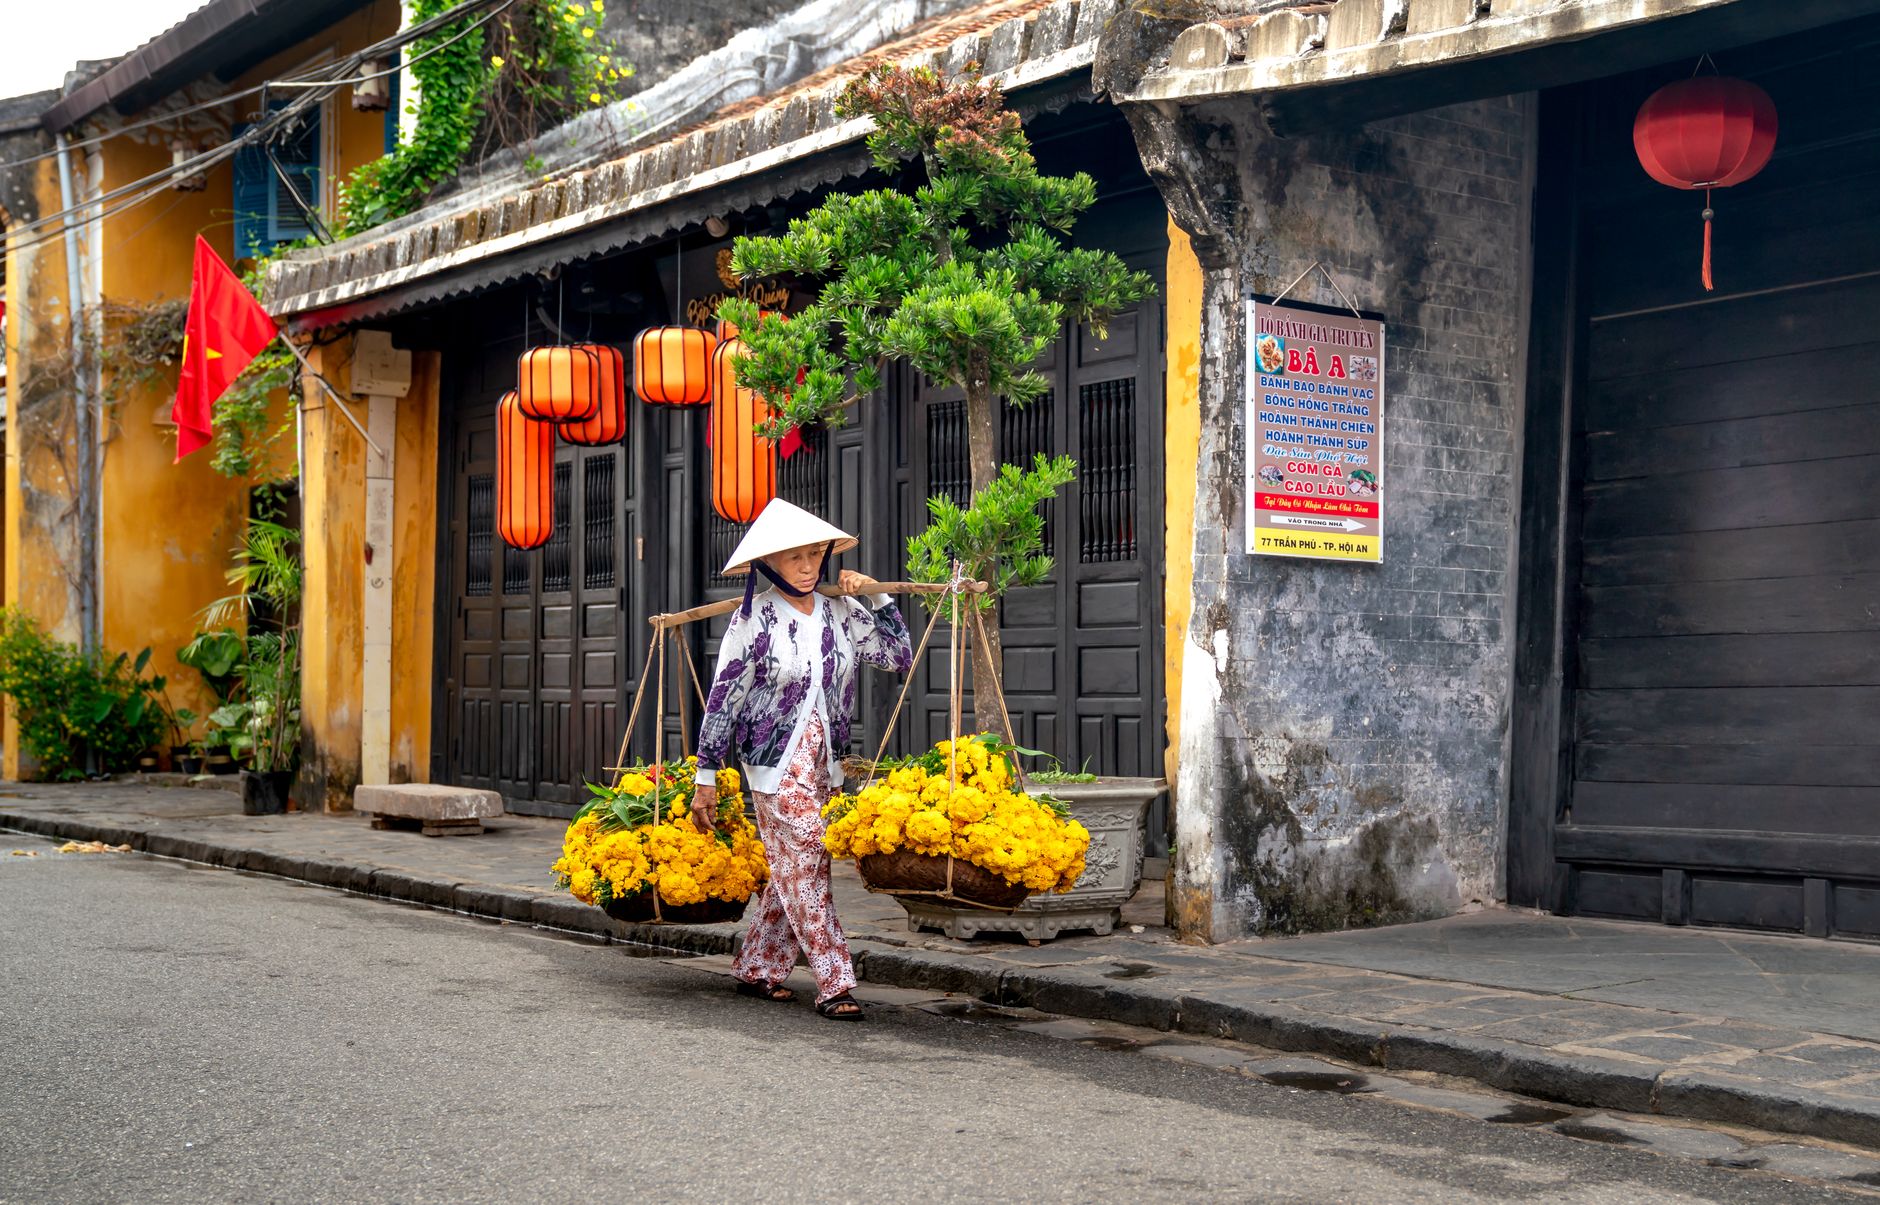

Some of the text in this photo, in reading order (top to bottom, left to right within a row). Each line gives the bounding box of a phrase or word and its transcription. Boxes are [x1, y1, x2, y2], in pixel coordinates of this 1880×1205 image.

[1260, 311, 1375, 349] LÒ BÁNH GIA TRUYỀN
[1287, 346, 1346, 378] BÀ A
[1294, 380, 1315, 392] BAO
[1318, 381, 1348, 396] BÁNH
[1352, 387, 1374, 402] VẠC
[1265, 393, 1294, 407] BÔNG
[1332, 400, 1369, 416] TRẮNG
[1259, 410, 1297, 426] HOÀNH
[1265, 428, 1304, 444] HOÀNH
[1347, 436, 1368, 450] SÚP
[1286, 460, 1342, 478] CƠM GÀ
[1284, 478, 1346, 496] CAO LẦU
[1262, 538, 1272, 546] 77
[1324, 542, 1336, 551] TP.
[1339, 542, 1354, 554] HỘI
